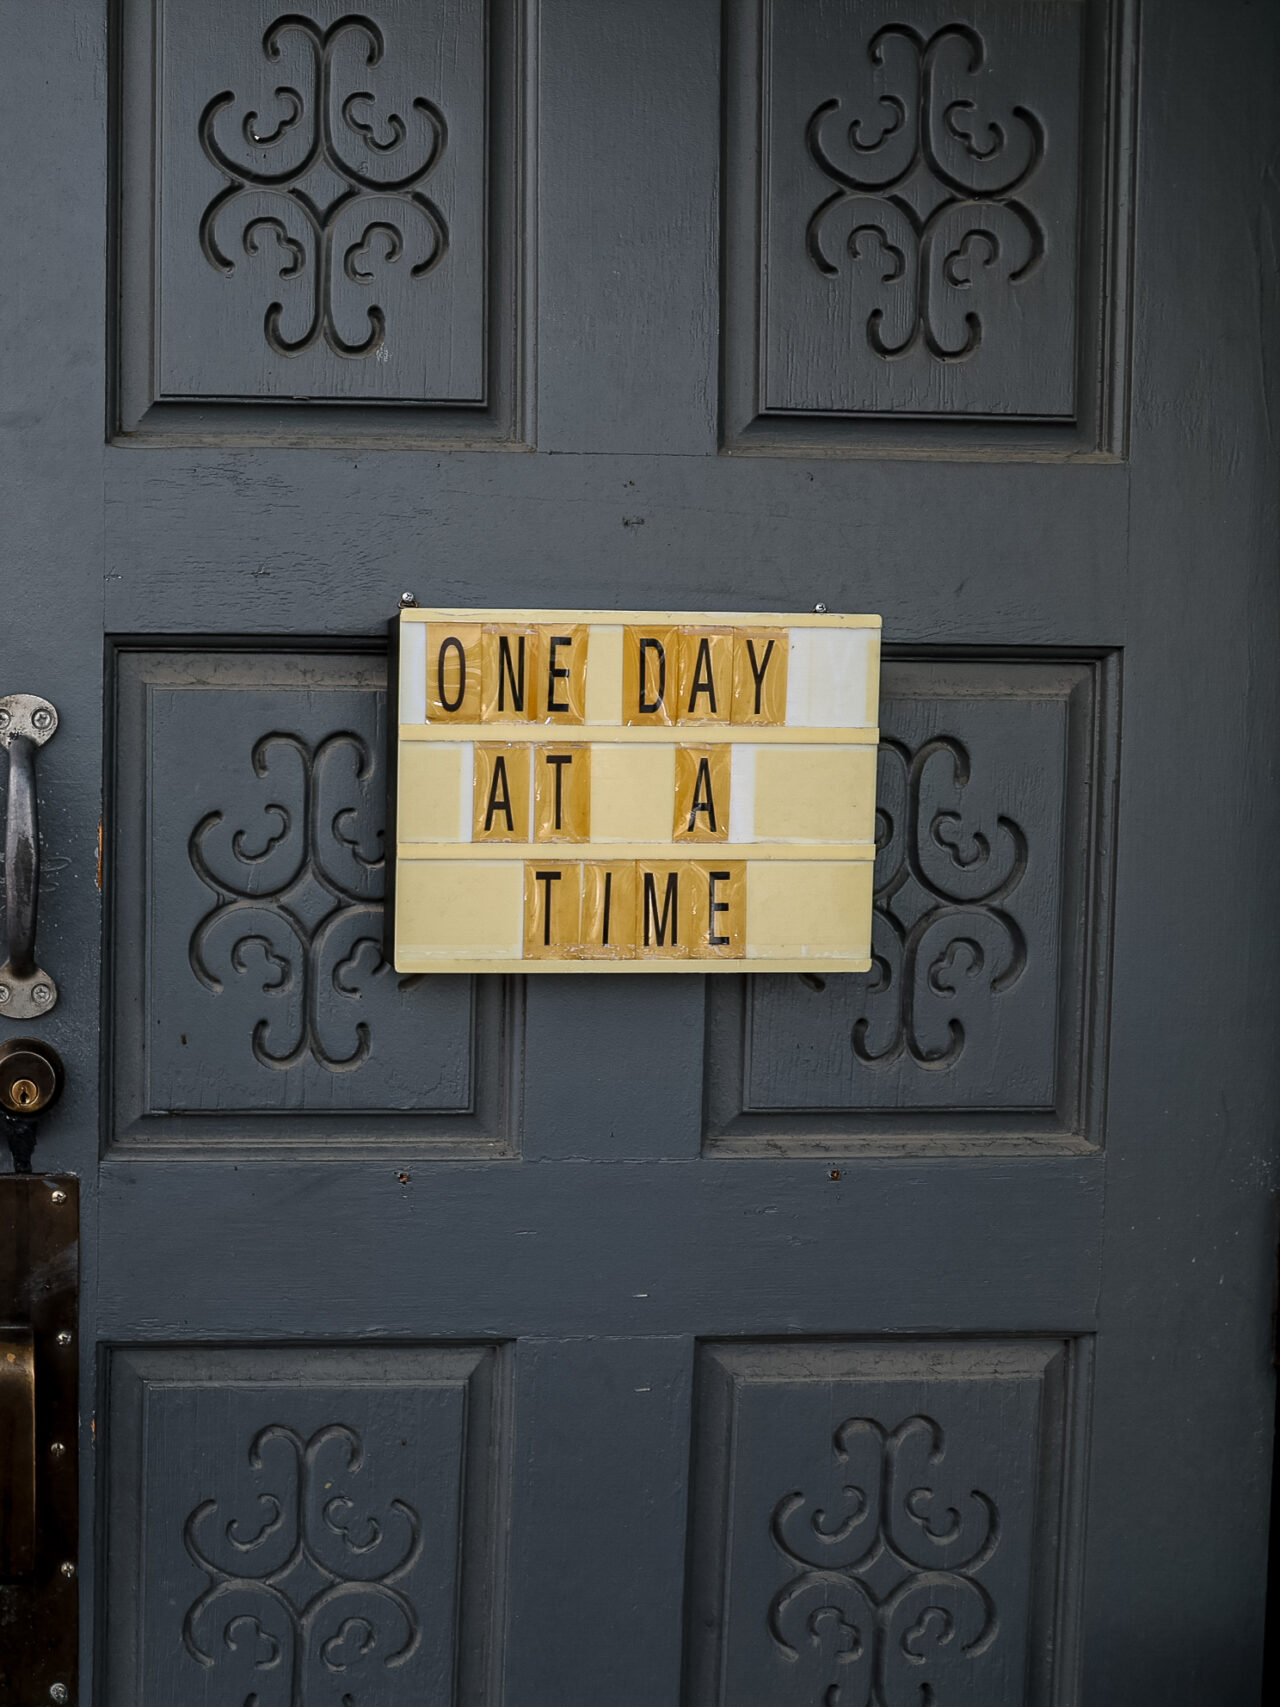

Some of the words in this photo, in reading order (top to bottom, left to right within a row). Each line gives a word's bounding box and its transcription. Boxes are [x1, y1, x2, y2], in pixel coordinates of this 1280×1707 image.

[437, 636, 572, 713] ONE
[638, 637, 776, 715] DAY
[484, 754, 573, 832] AT
[687, 757, 718, 833] A
[535, 871, 731, 947] TIME
